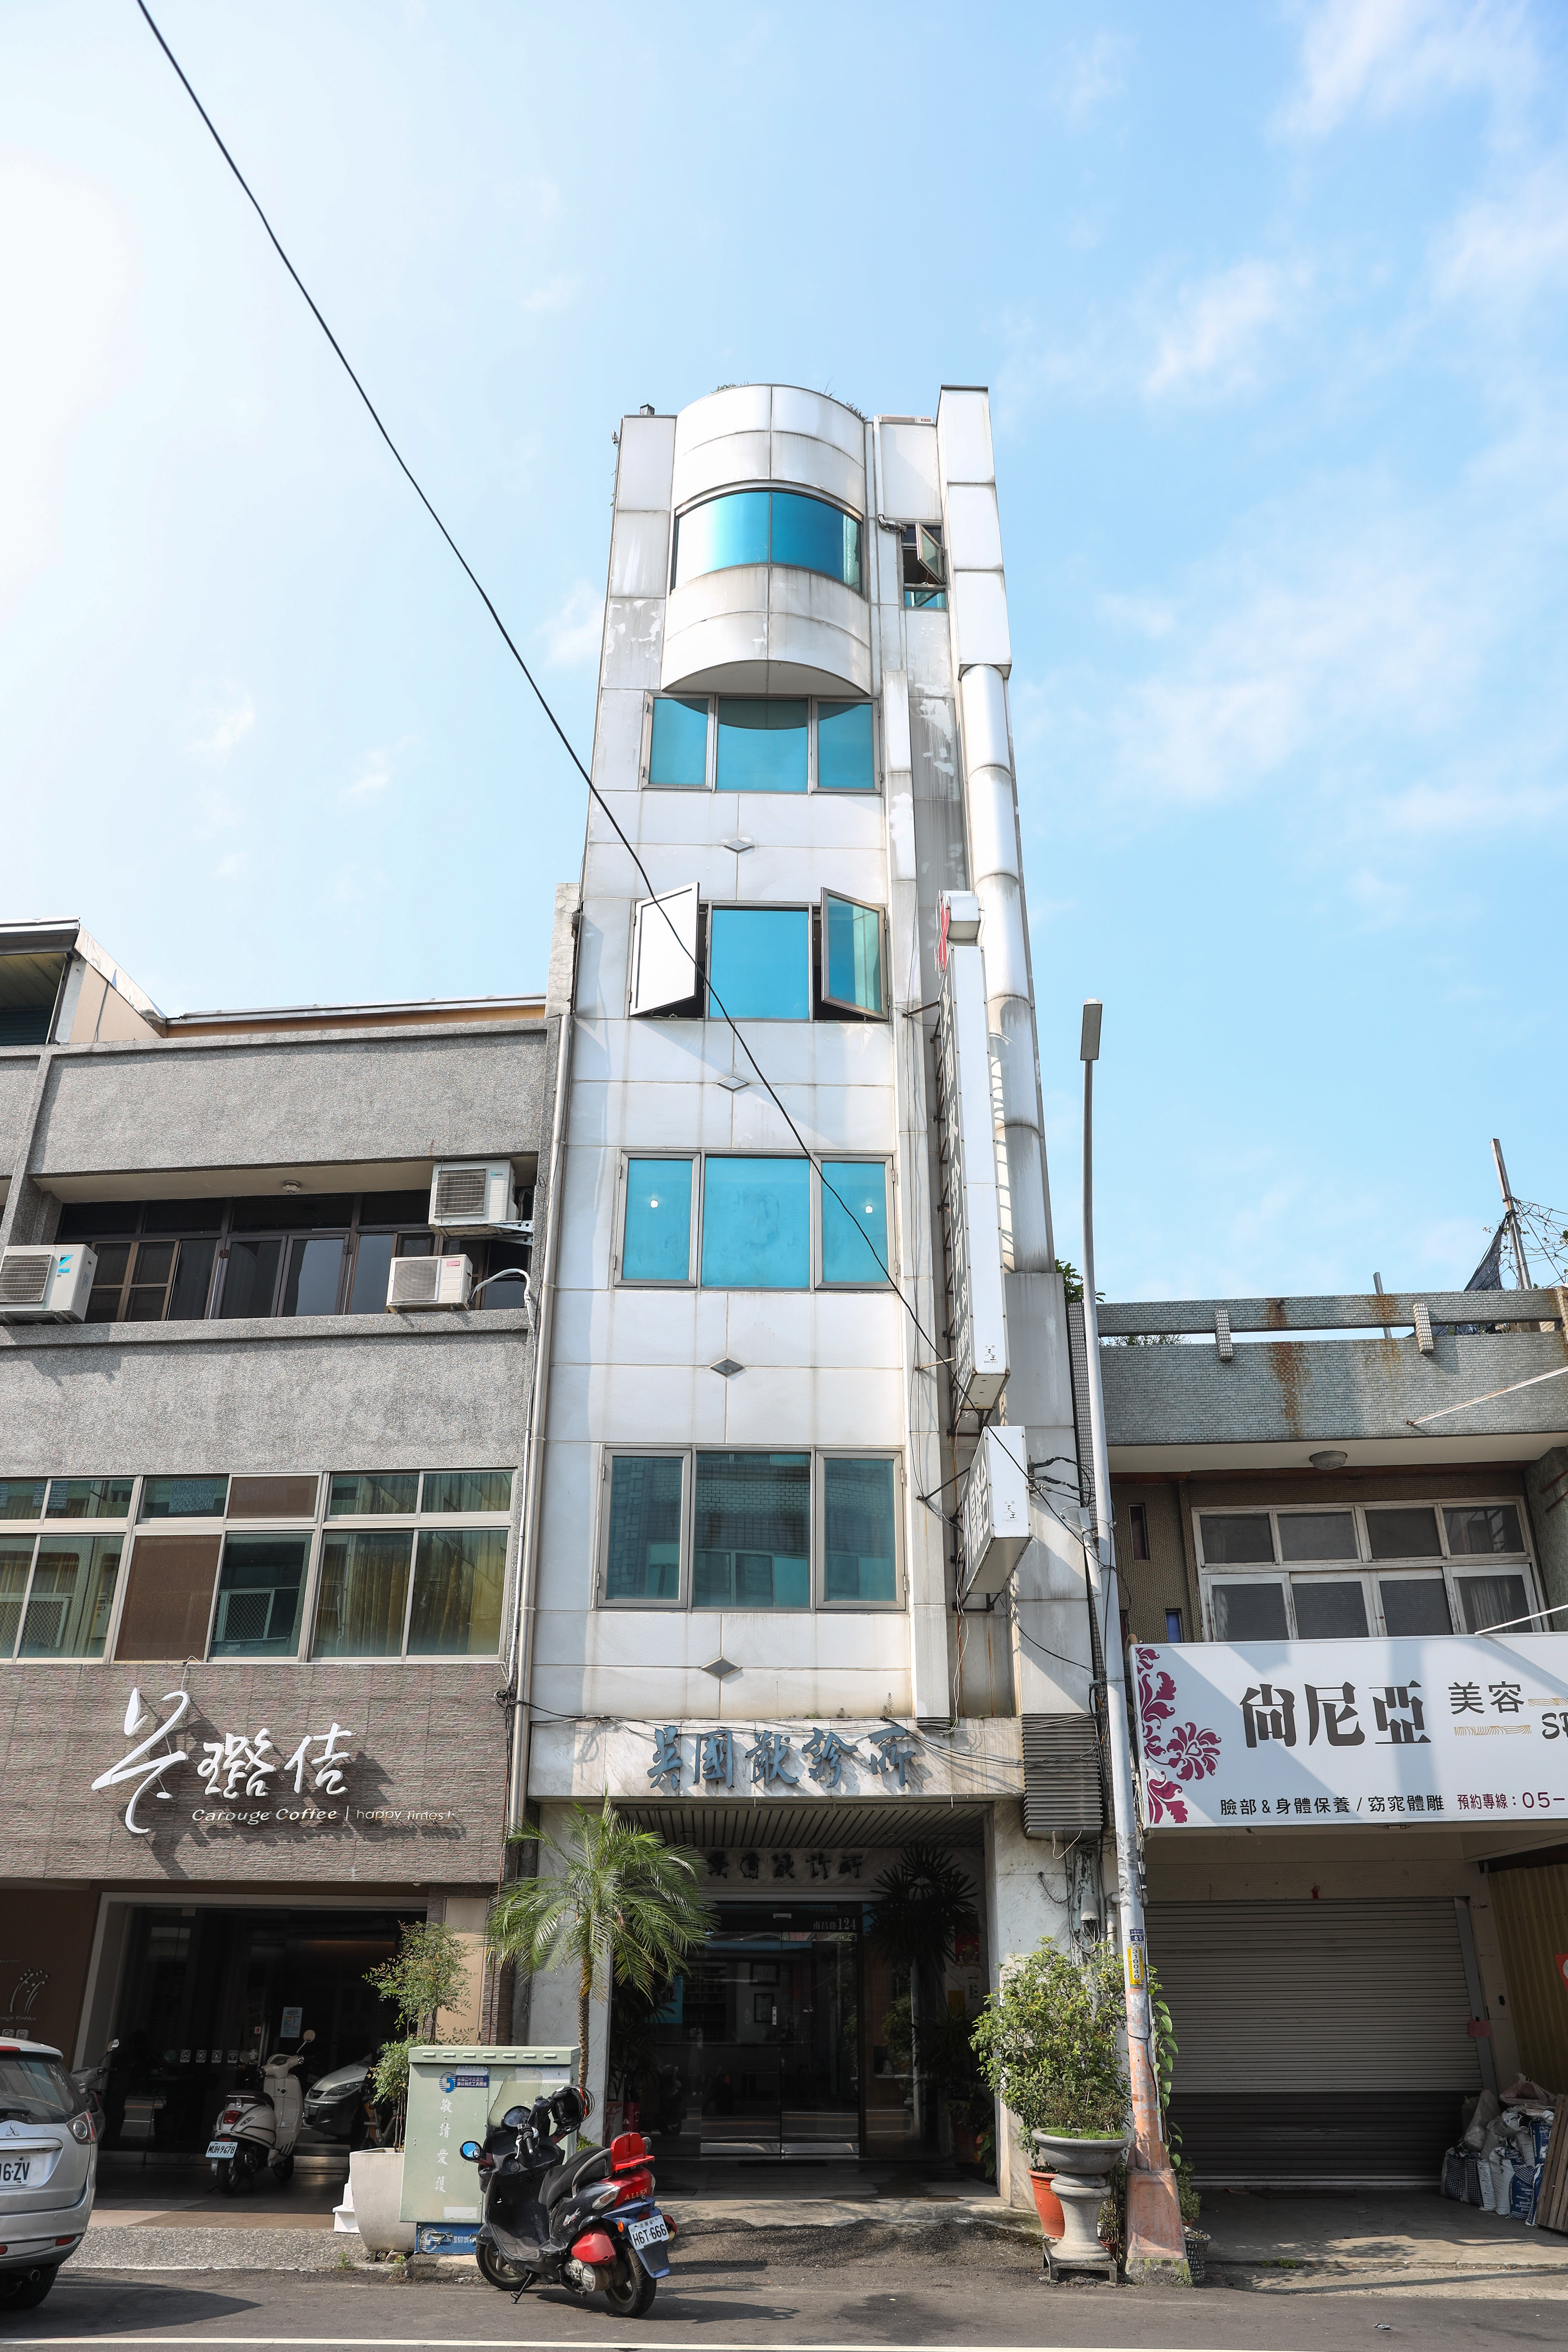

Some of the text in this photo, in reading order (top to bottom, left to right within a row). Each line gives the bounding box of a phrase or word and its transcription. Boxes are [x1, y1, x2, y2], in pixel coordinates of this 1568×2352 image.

[1448, 1681, 1525, 1715] 美容
[192, 1809, 270, 1825] Carouge
[276, 1808, 338, 1820] Coffee
[357, 1810, 401, 1821] happy
[208, 2146, 235, 2154] MUH-9678
[435, 2098, 452, 2193] 敬請愛護
[624, 2188, 648, 2200] ALLEN
